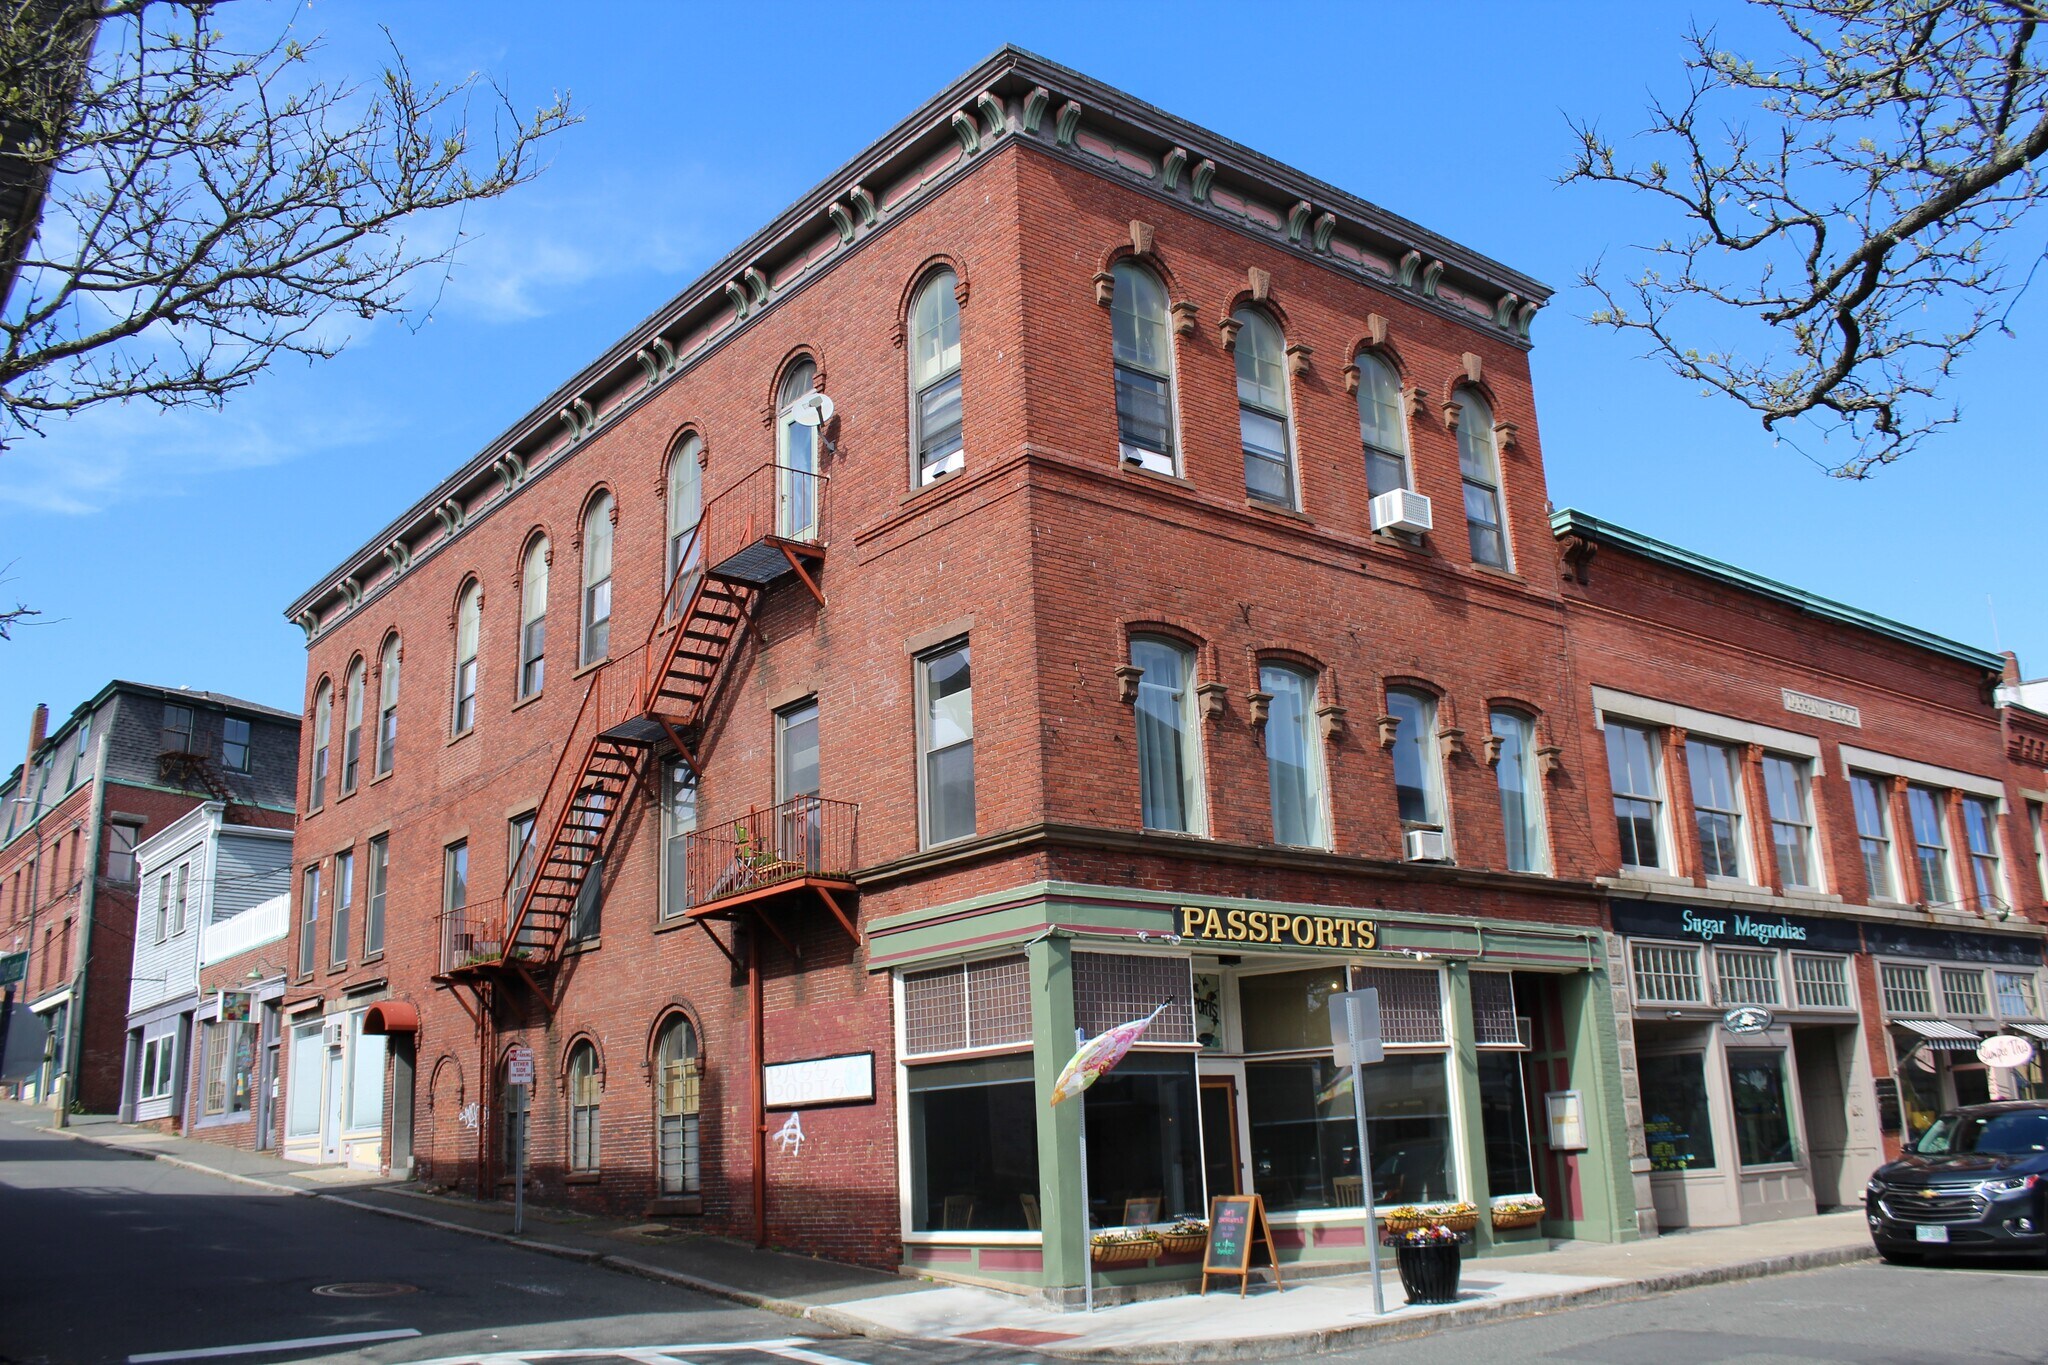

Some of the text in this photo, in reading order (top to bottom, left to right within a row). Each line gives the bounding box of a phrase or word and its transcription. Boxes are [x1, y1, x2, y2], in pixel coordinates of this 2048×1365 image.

[1181, 906, 1376, 949] PASSPORTS
[1682, 909, 1807, 945] Sugar Magnolias
[768, 1062, 829, 1085] PASS
[770, 1078, 845, 1103] PORTS
